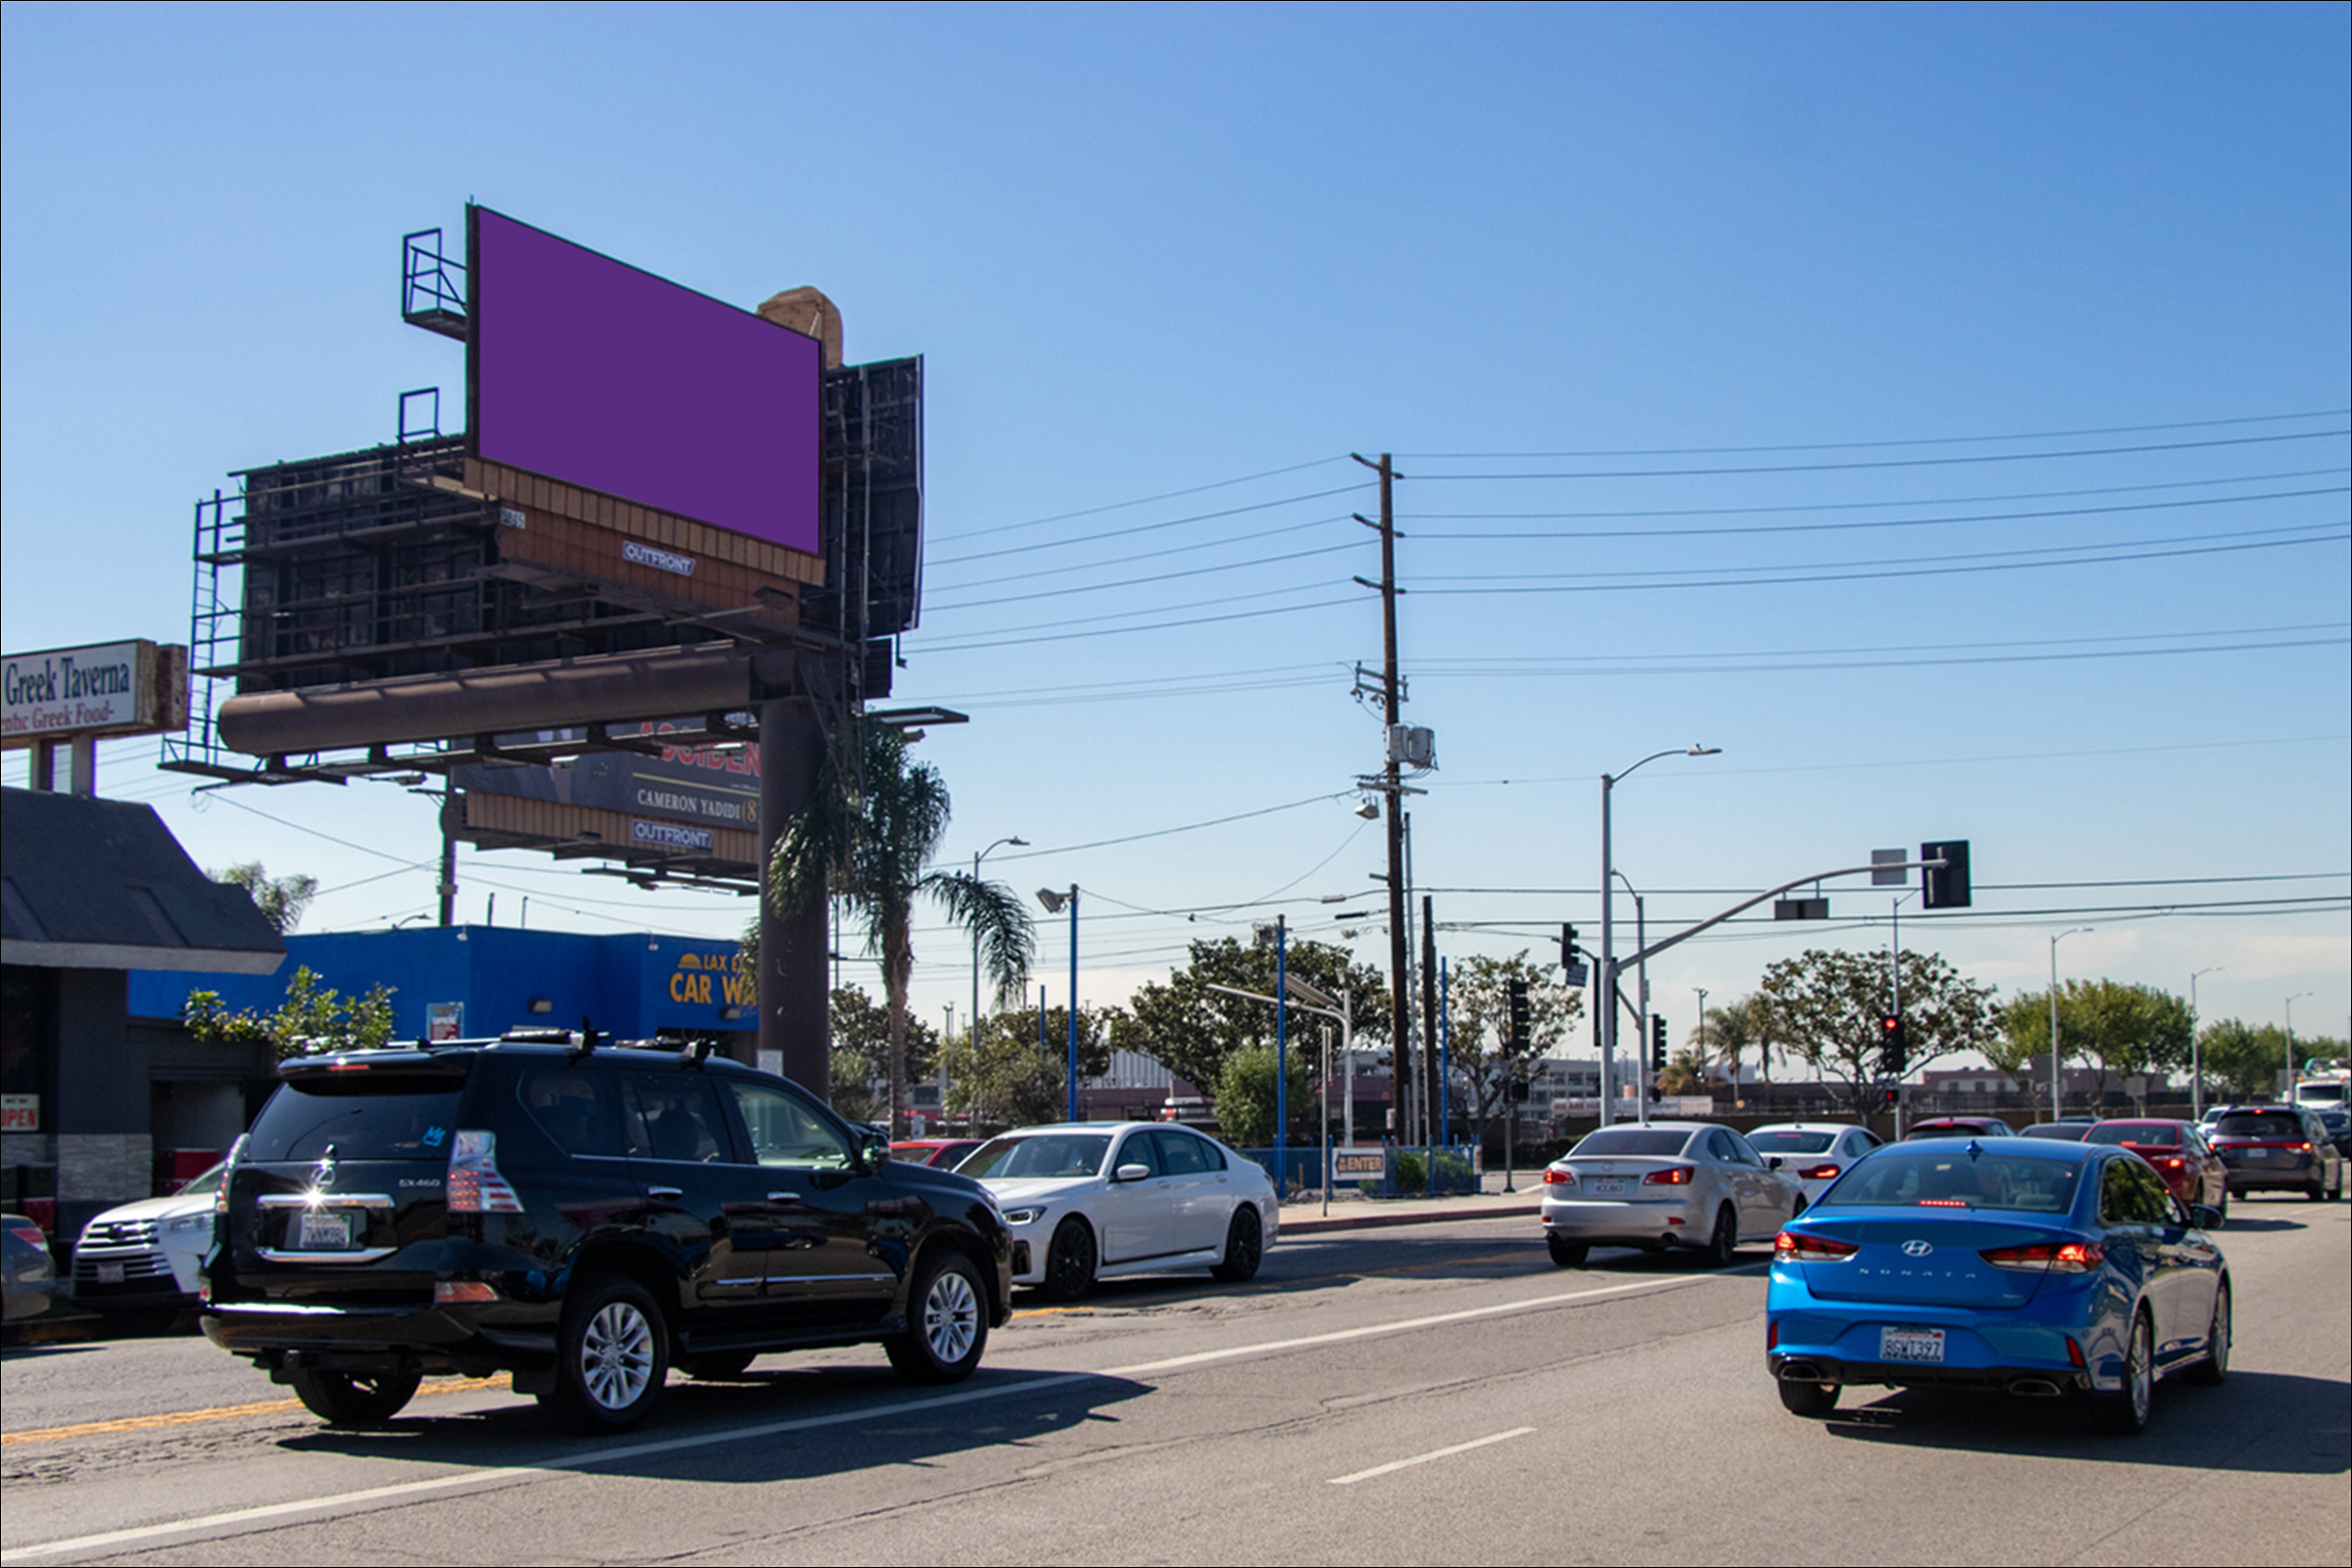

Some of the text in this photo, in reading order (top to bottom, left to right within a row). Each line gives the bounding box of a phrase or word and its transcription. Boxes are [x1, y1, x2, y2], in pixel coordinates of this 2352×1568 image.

[625, 545, 691, 573] OUTFRONT
[5, 656, 129, 706] Greek Taverna
[32, 705, 73, 729] Greek
[75, 700, 114, 725] Food-
[637, 788, 698, 813] CAMERON
[700, 798, 741, 820] YADIDI
[635, 822, 710, 847] OUTFRONT
[703, 954, 727, 972] LAX
[670, 972, 758, 1006] CAR WA
[1, 1107, 37, 1127] OPEN
[1348, 1156, 1382, 1171] ENTER
